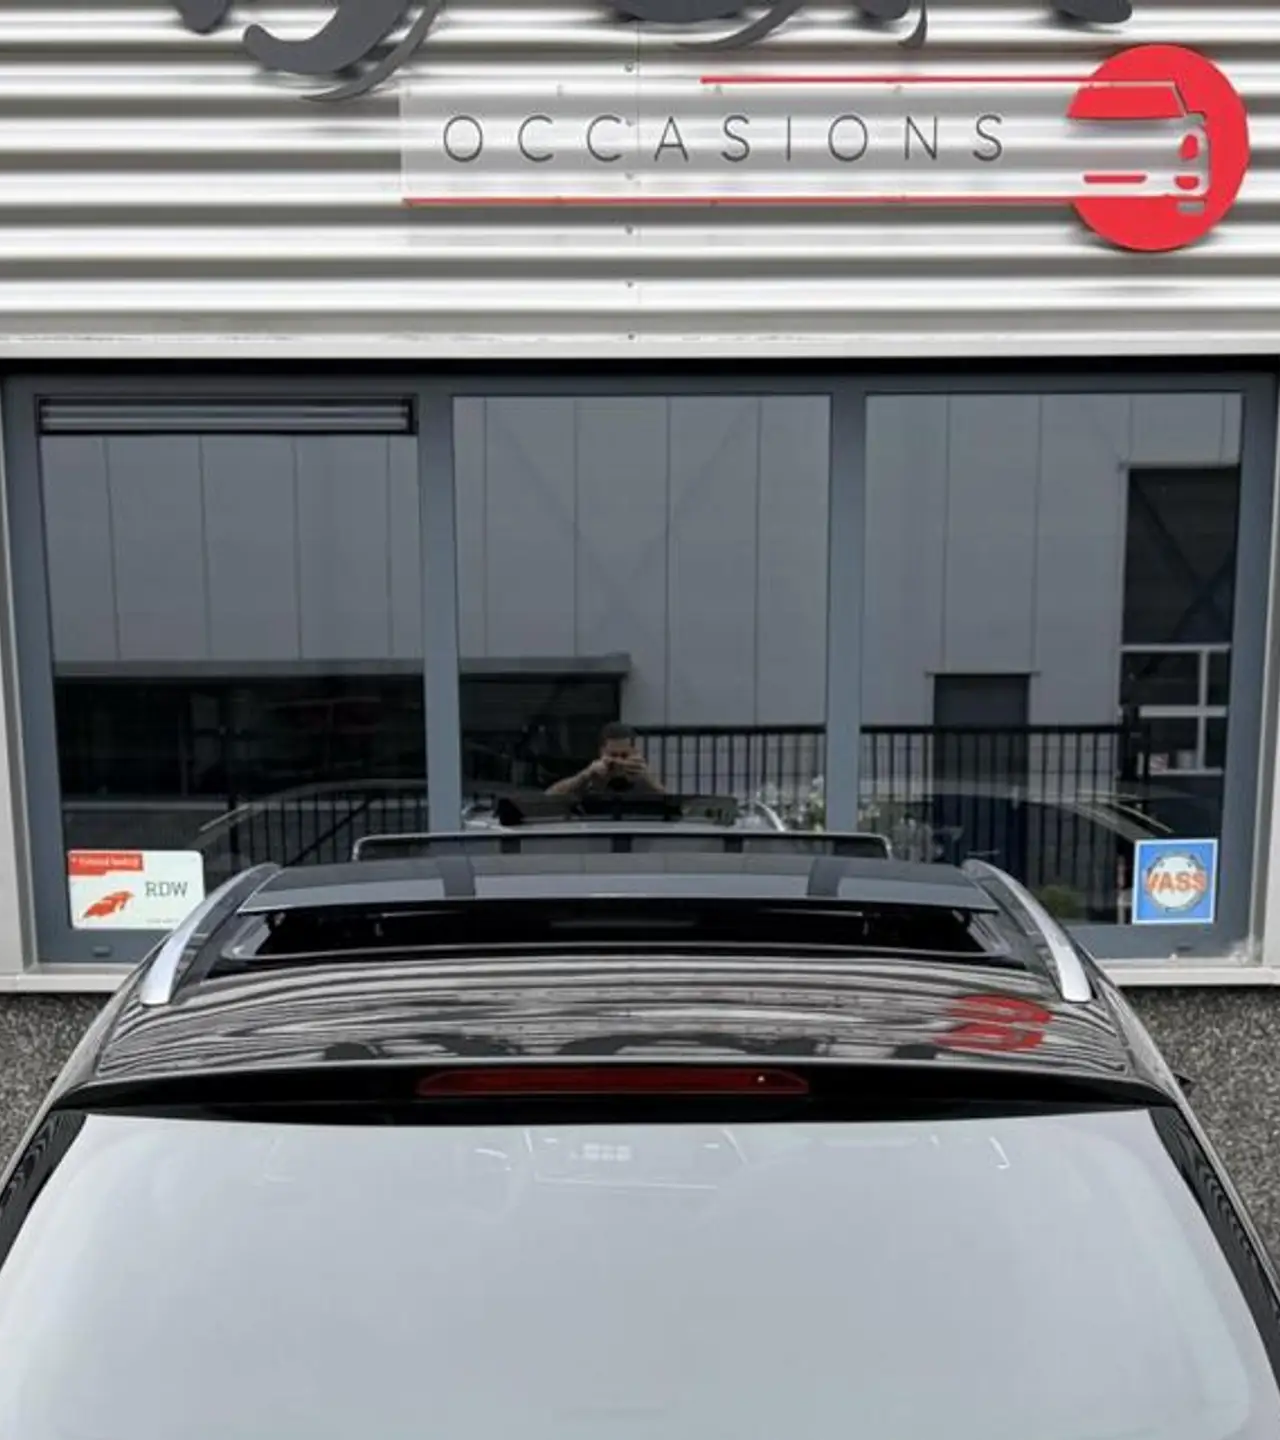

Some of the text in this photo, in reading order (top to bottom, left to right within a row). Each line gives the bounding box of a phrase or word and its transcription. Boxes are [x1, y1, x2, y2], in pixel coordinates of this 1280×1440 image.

[440, 114, 1006, 164] OCCASIONS
[145, 881, 188, 898] RDW
[1146, 871, 1206, 893] VASS
